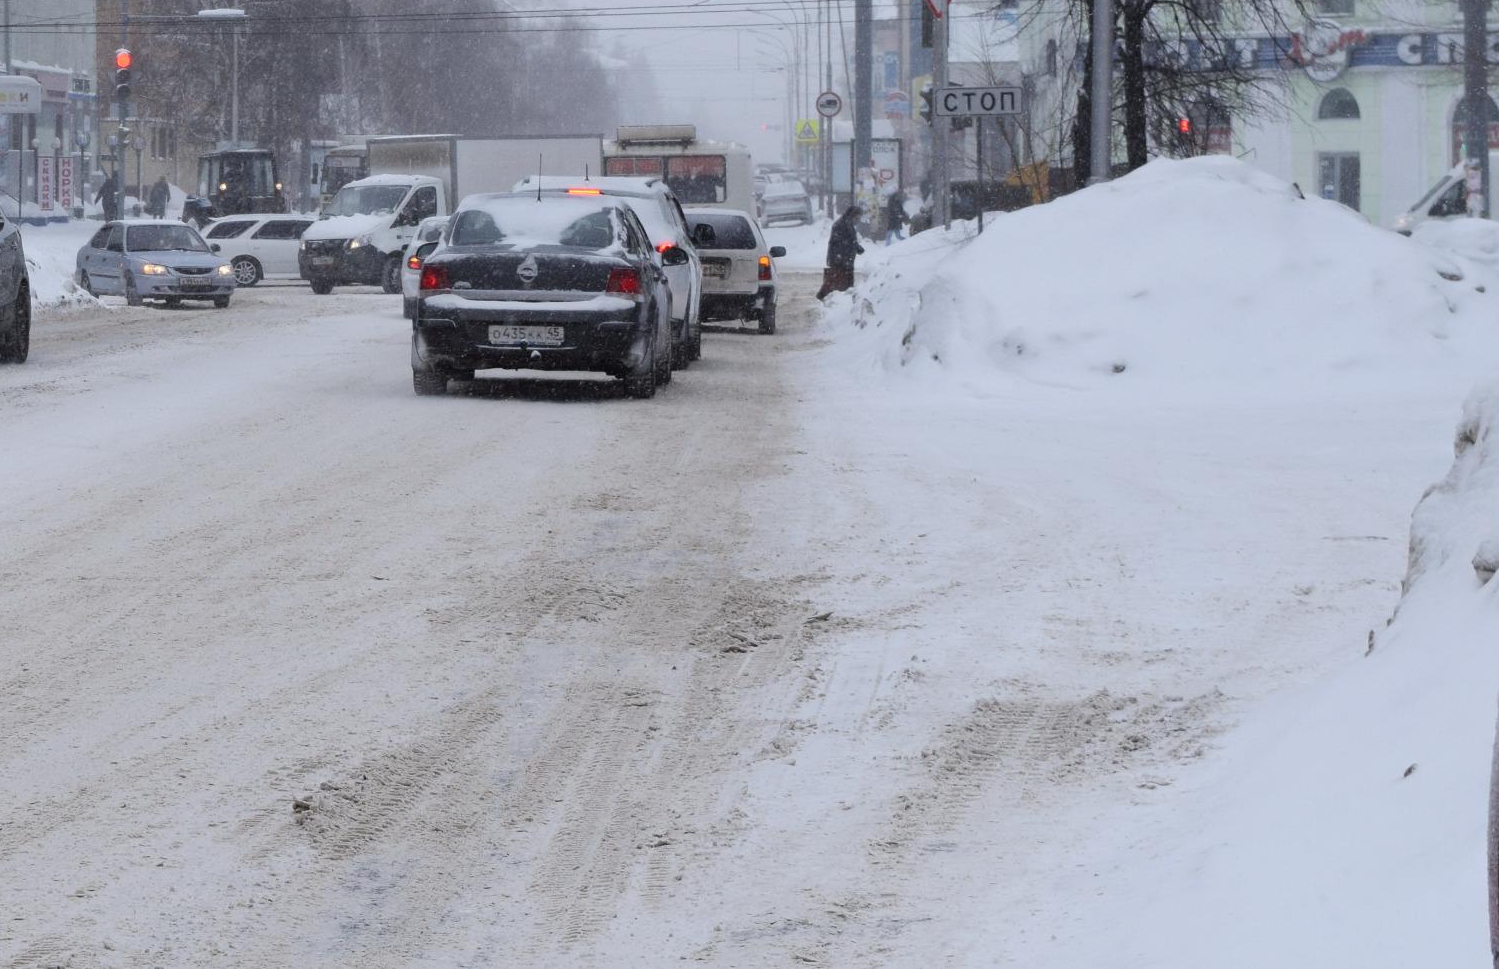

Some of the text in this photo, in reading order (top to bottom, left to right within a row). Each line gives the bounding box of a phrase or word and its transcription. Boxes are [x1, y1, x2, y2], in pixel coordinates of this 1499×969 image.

[944, 91, 1015, 112] СТОП
[62, 158, 71, 208] НОРКА
[547, 327, 560, 337] 45
